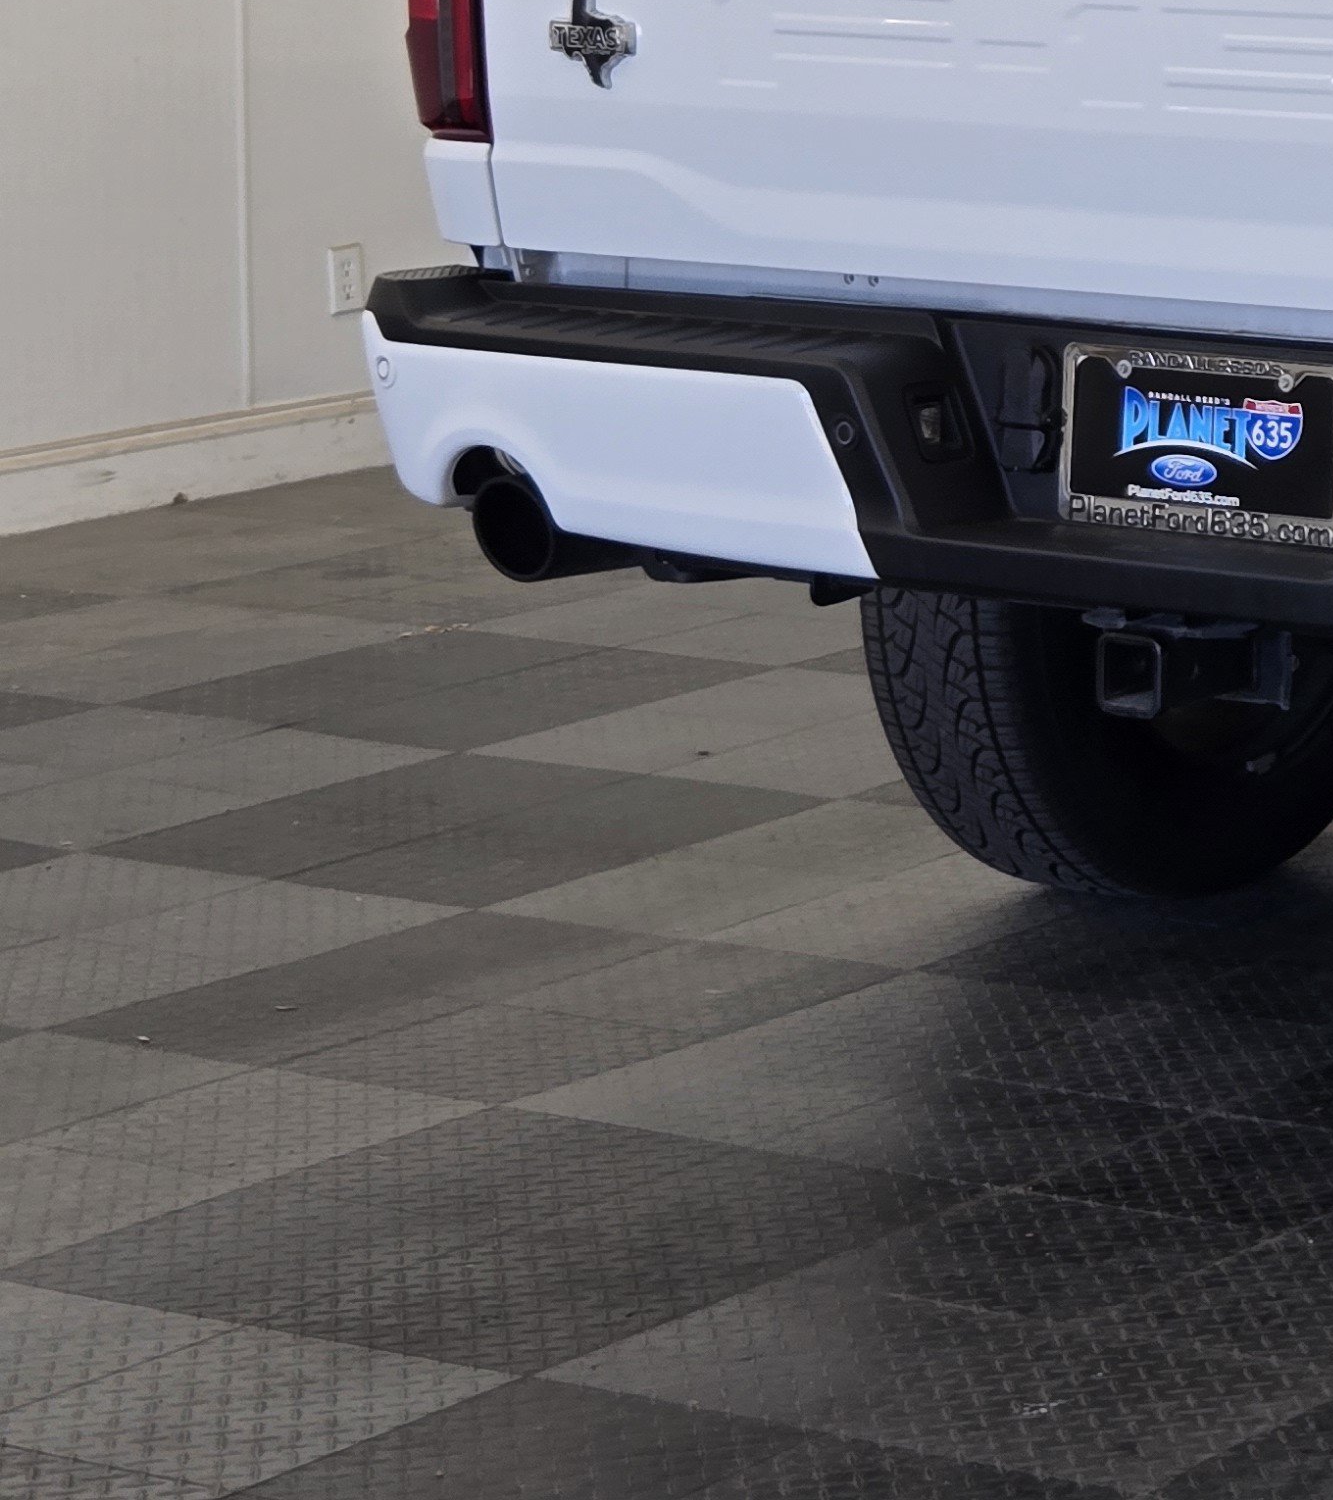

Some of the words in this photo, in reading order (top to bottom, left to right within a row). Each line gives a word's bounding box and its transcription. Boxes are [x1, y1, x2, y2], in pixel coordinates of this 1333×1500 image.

[552, 25, 618, 48] TEXAS
[1121, 386, 1252, 459] PLANET
[1252, 418, 1293, 450] 635
[1163, 460, 1204, 482] Ford
[1127, 484, 1240, 507] PlanetFord635.com
[1068, 494, 1333, 546] PlanetFord635.com
